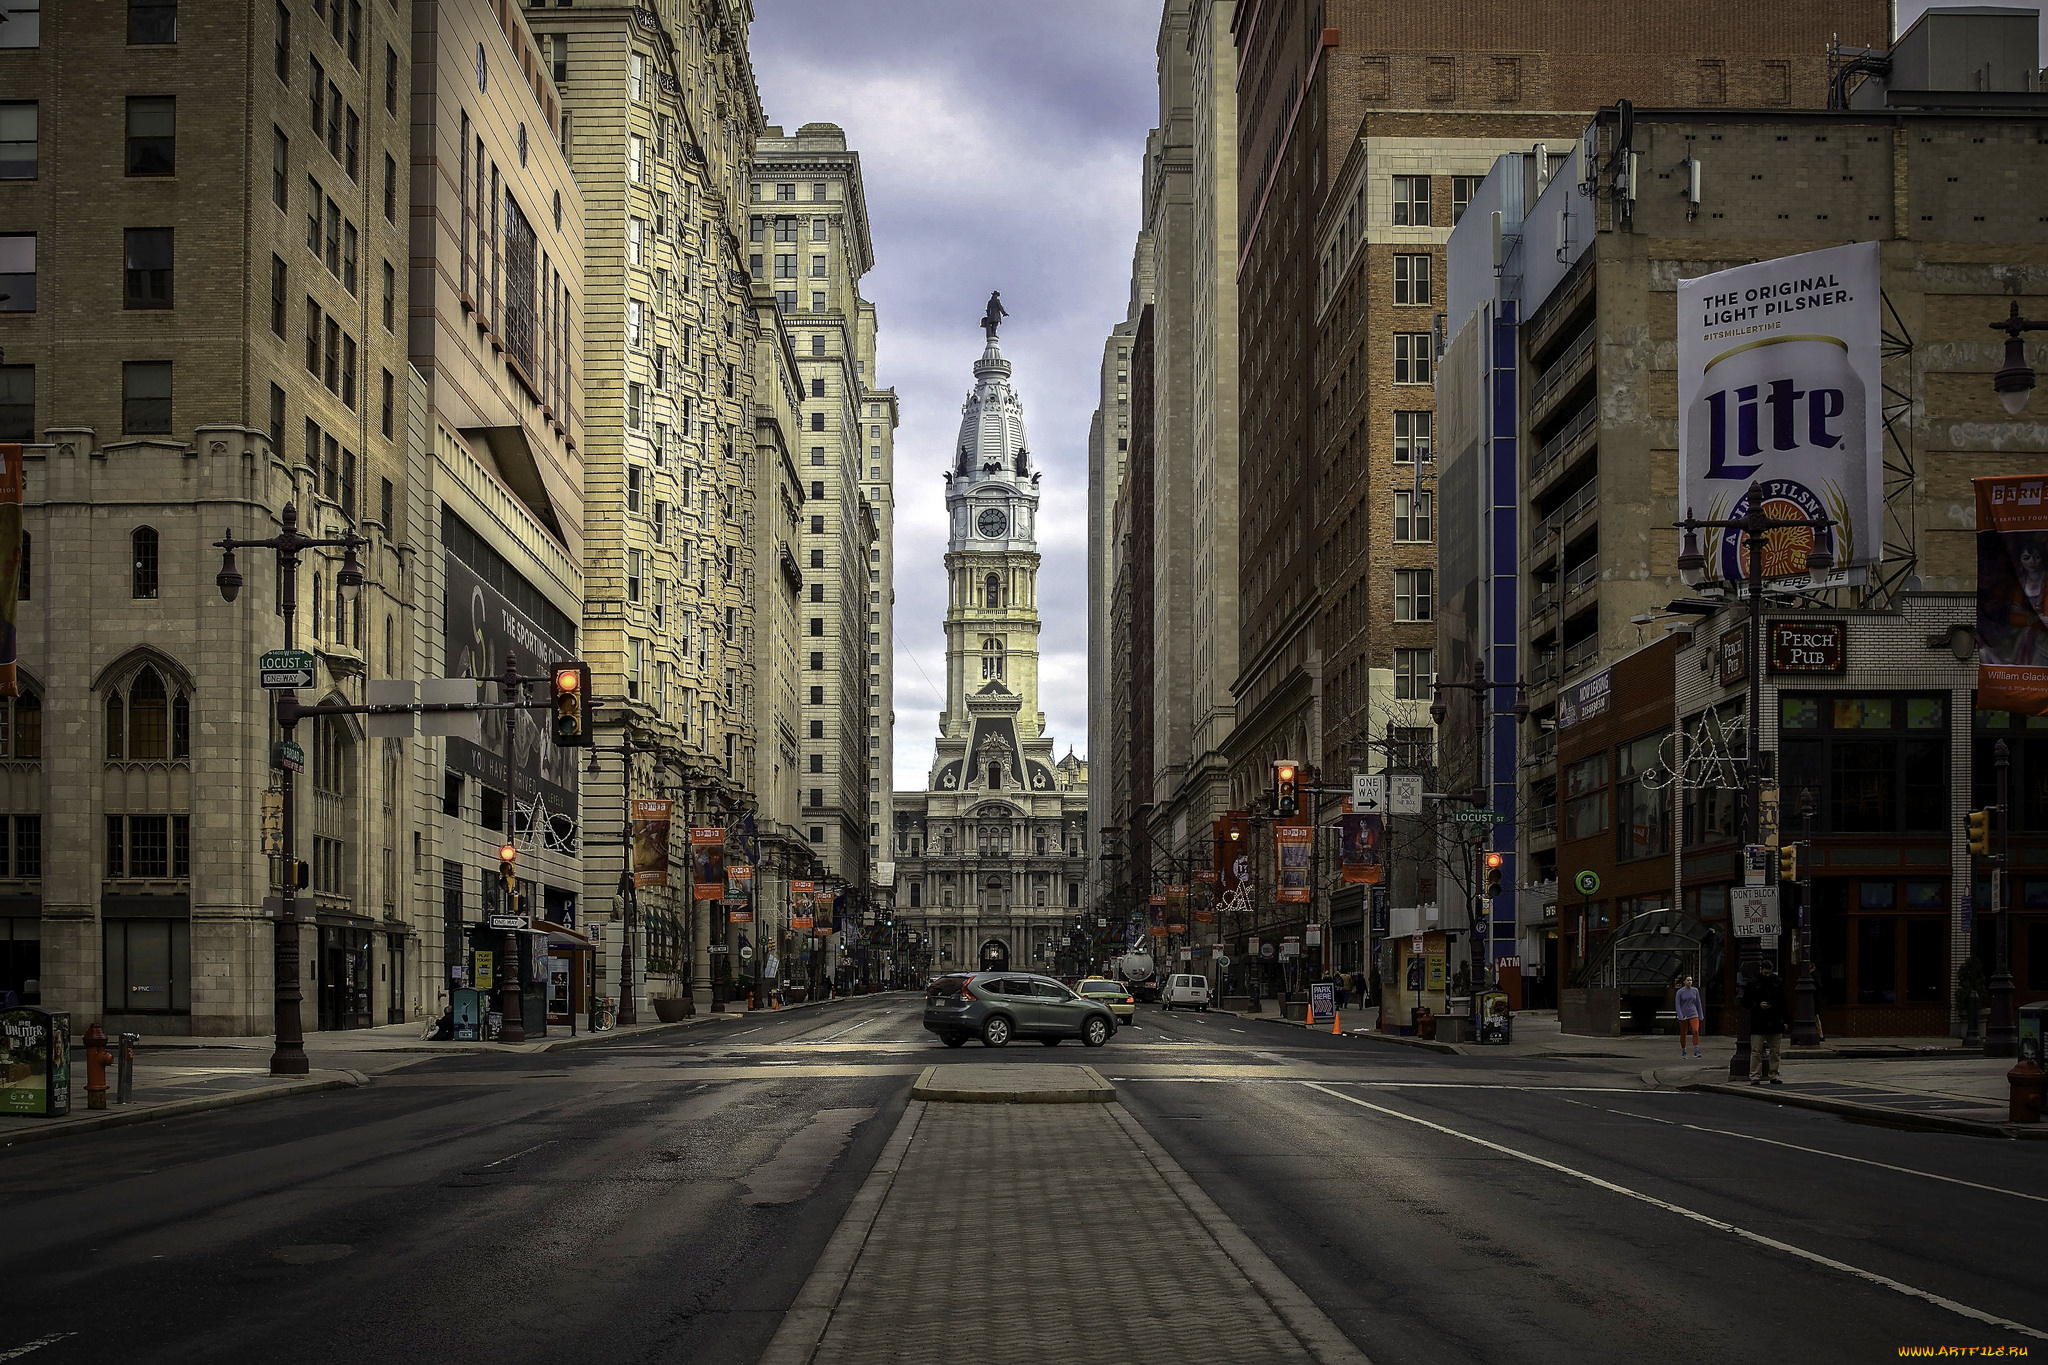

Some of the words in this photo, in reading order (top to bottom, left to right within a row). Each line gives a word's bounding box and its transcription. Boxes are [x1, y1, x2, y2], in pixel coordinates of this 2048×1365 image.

[1703, 291, 1739, 310] THE
[1744, 274, 1839, 302] ORIGINAL
[1704, 305, 1758, 327] LIGHT
[1765, 290, 1854, 316] PILSNER.
[1703, 321, 1781, 341] #ITSMILLERTIME
[1703, 378, 1844, 480] Lite
[501, 609, 516, 638] THE
[517, 621, 547, 664] SPORTING
[1780, 630, 1835, 648] PERCH
[1724, 639, 1742, 659] PERCH
[1791, 648, 1825, 664] PUB
[261, 657, 300, 669] LOCUST
[303, 660, 313, 668] ST
[1727, 658, 1739, 674] PUB
[266, 674, 281, 682] ONE
[282, 674, 298, 682] WAY
[1987, 671, 2020, 681] William
[471, 748, 486, 773] YOU
[489, 757, 507, 783] HAVE
[1359, 778, 1379, 787] ONE
[1358, 788, 1379, 797] WAY
[1455, 813, 1493, 822] LOCUST
[1754, 889, 1776, 898] BLOCK
[1737, 924, 1755, 934] THE
[1500, 957, 1520, 968] ATM
[1313, 992, 1332, 1000] HERE
[5, 1024, 42, 1037] UNLITTER
[24, 1036, 36, 1047] US
